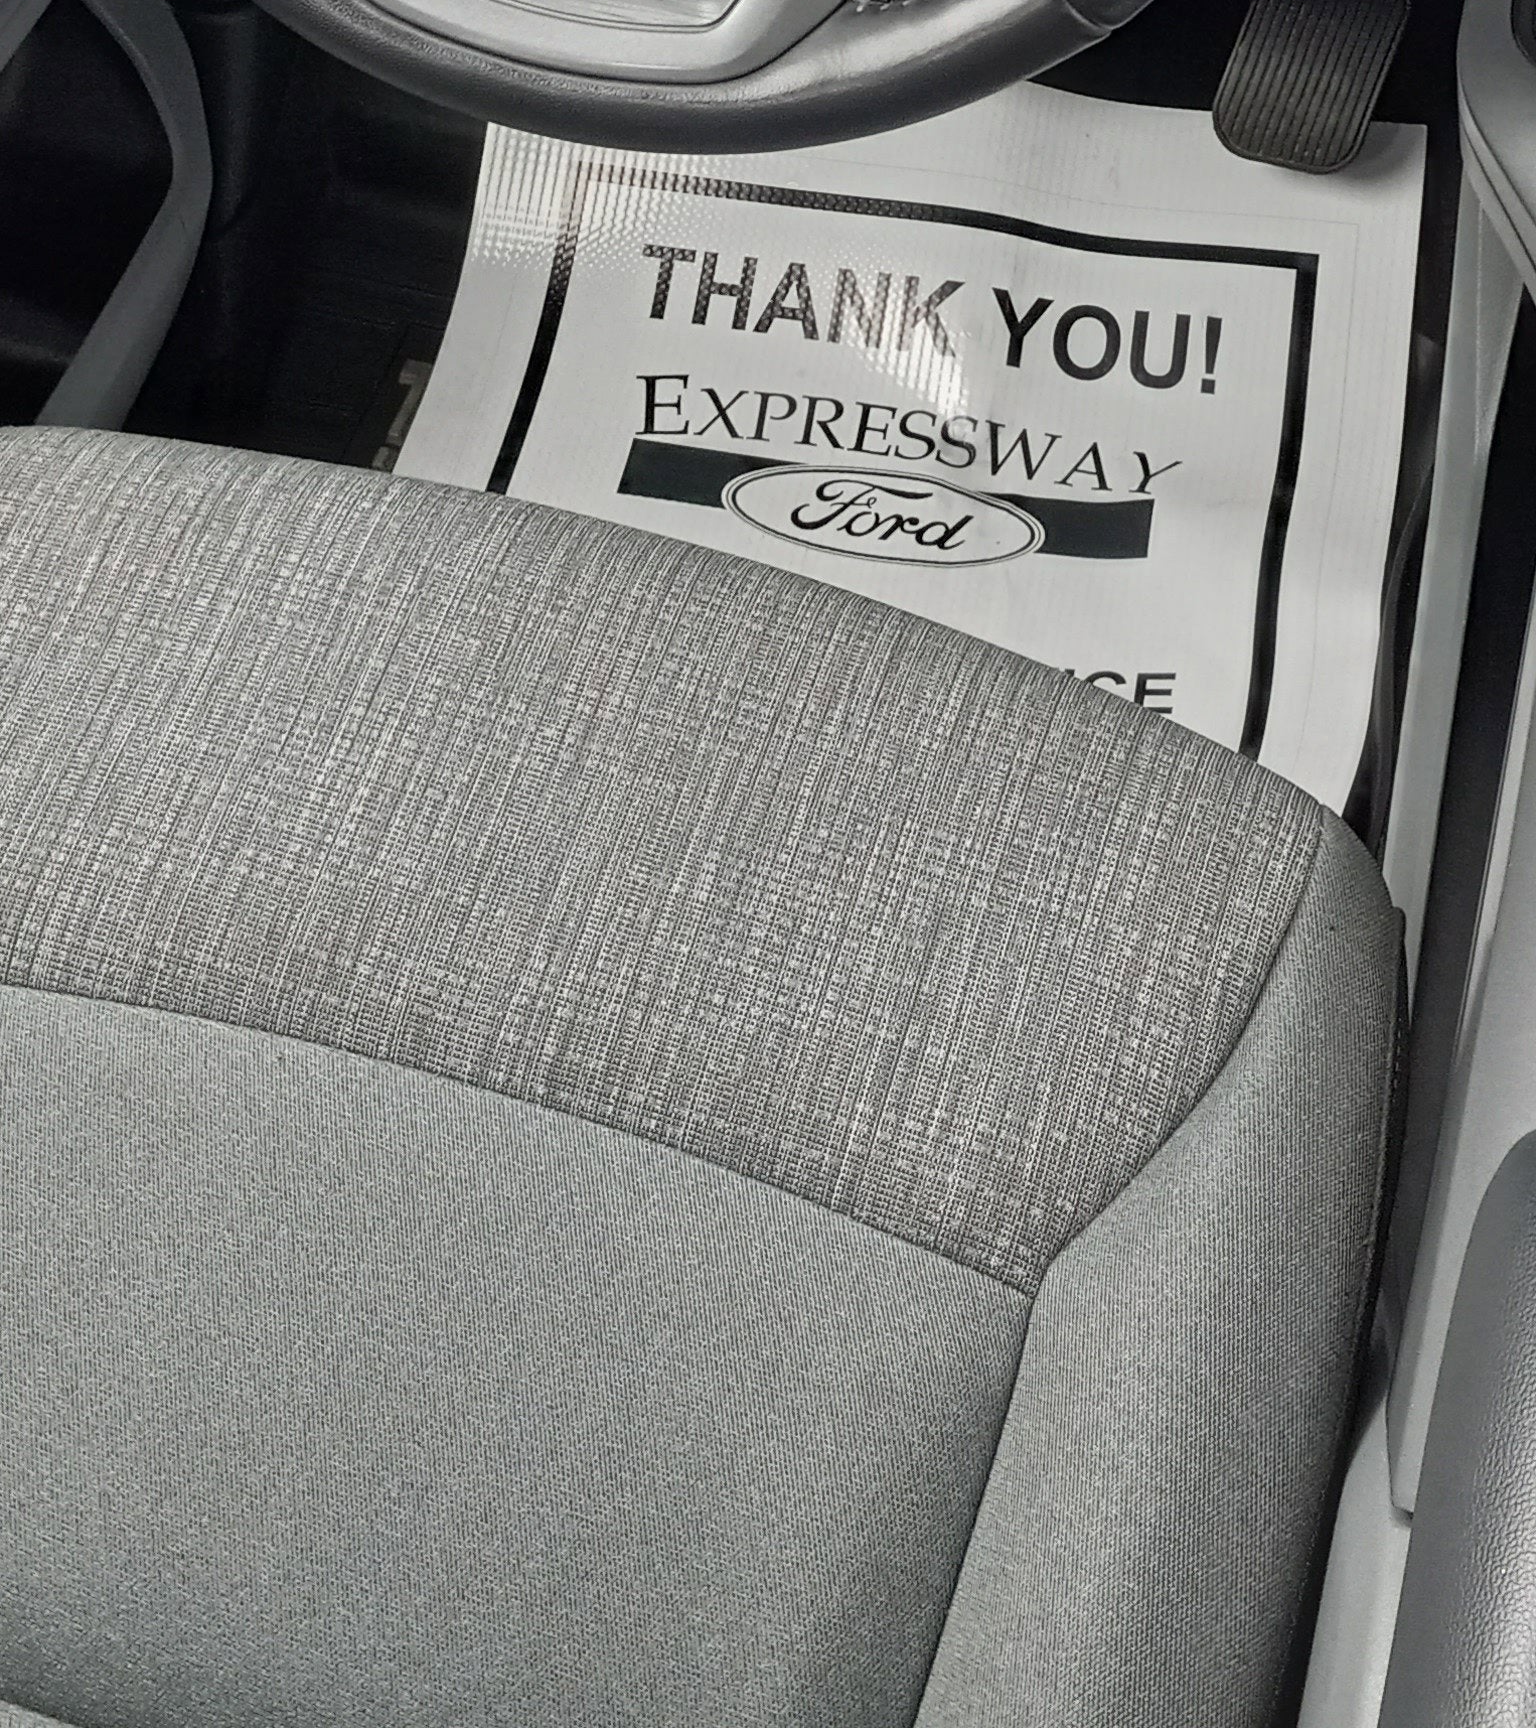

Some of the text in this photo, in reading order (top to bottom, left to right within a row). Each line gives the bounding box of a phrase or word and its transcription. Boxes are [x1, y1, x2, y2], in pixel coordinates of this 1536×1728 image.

[641, 244, 1225, 397] THANK YOU!
[636, 373, 1184, 496] EXPRESSWAY
[791, 479, 973, 553] Ford
